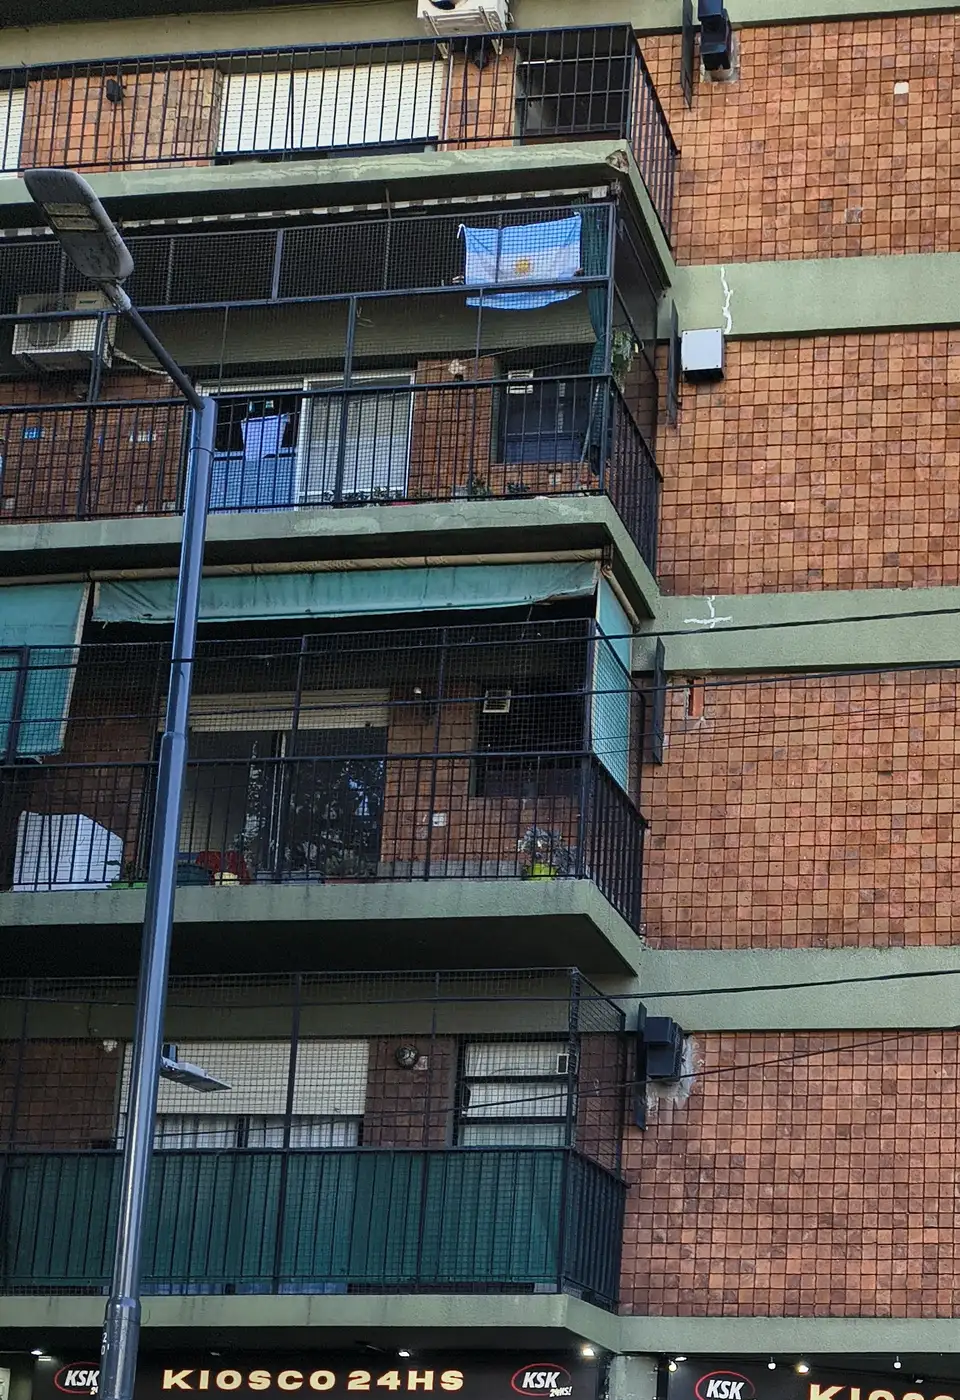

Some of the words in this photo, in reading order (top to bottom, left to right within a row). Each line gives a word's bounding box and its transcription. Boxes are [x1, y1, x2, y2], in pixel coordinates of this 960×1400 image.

[65, 1370, 100, 1386] KSK
[162, 1369, 336, 1391] KIOSCO
[347, 1370, 464, 1391] 24HS
[522, 1372, 560, 1388] KSK
[706, 1380, 745, 1400] KSK
